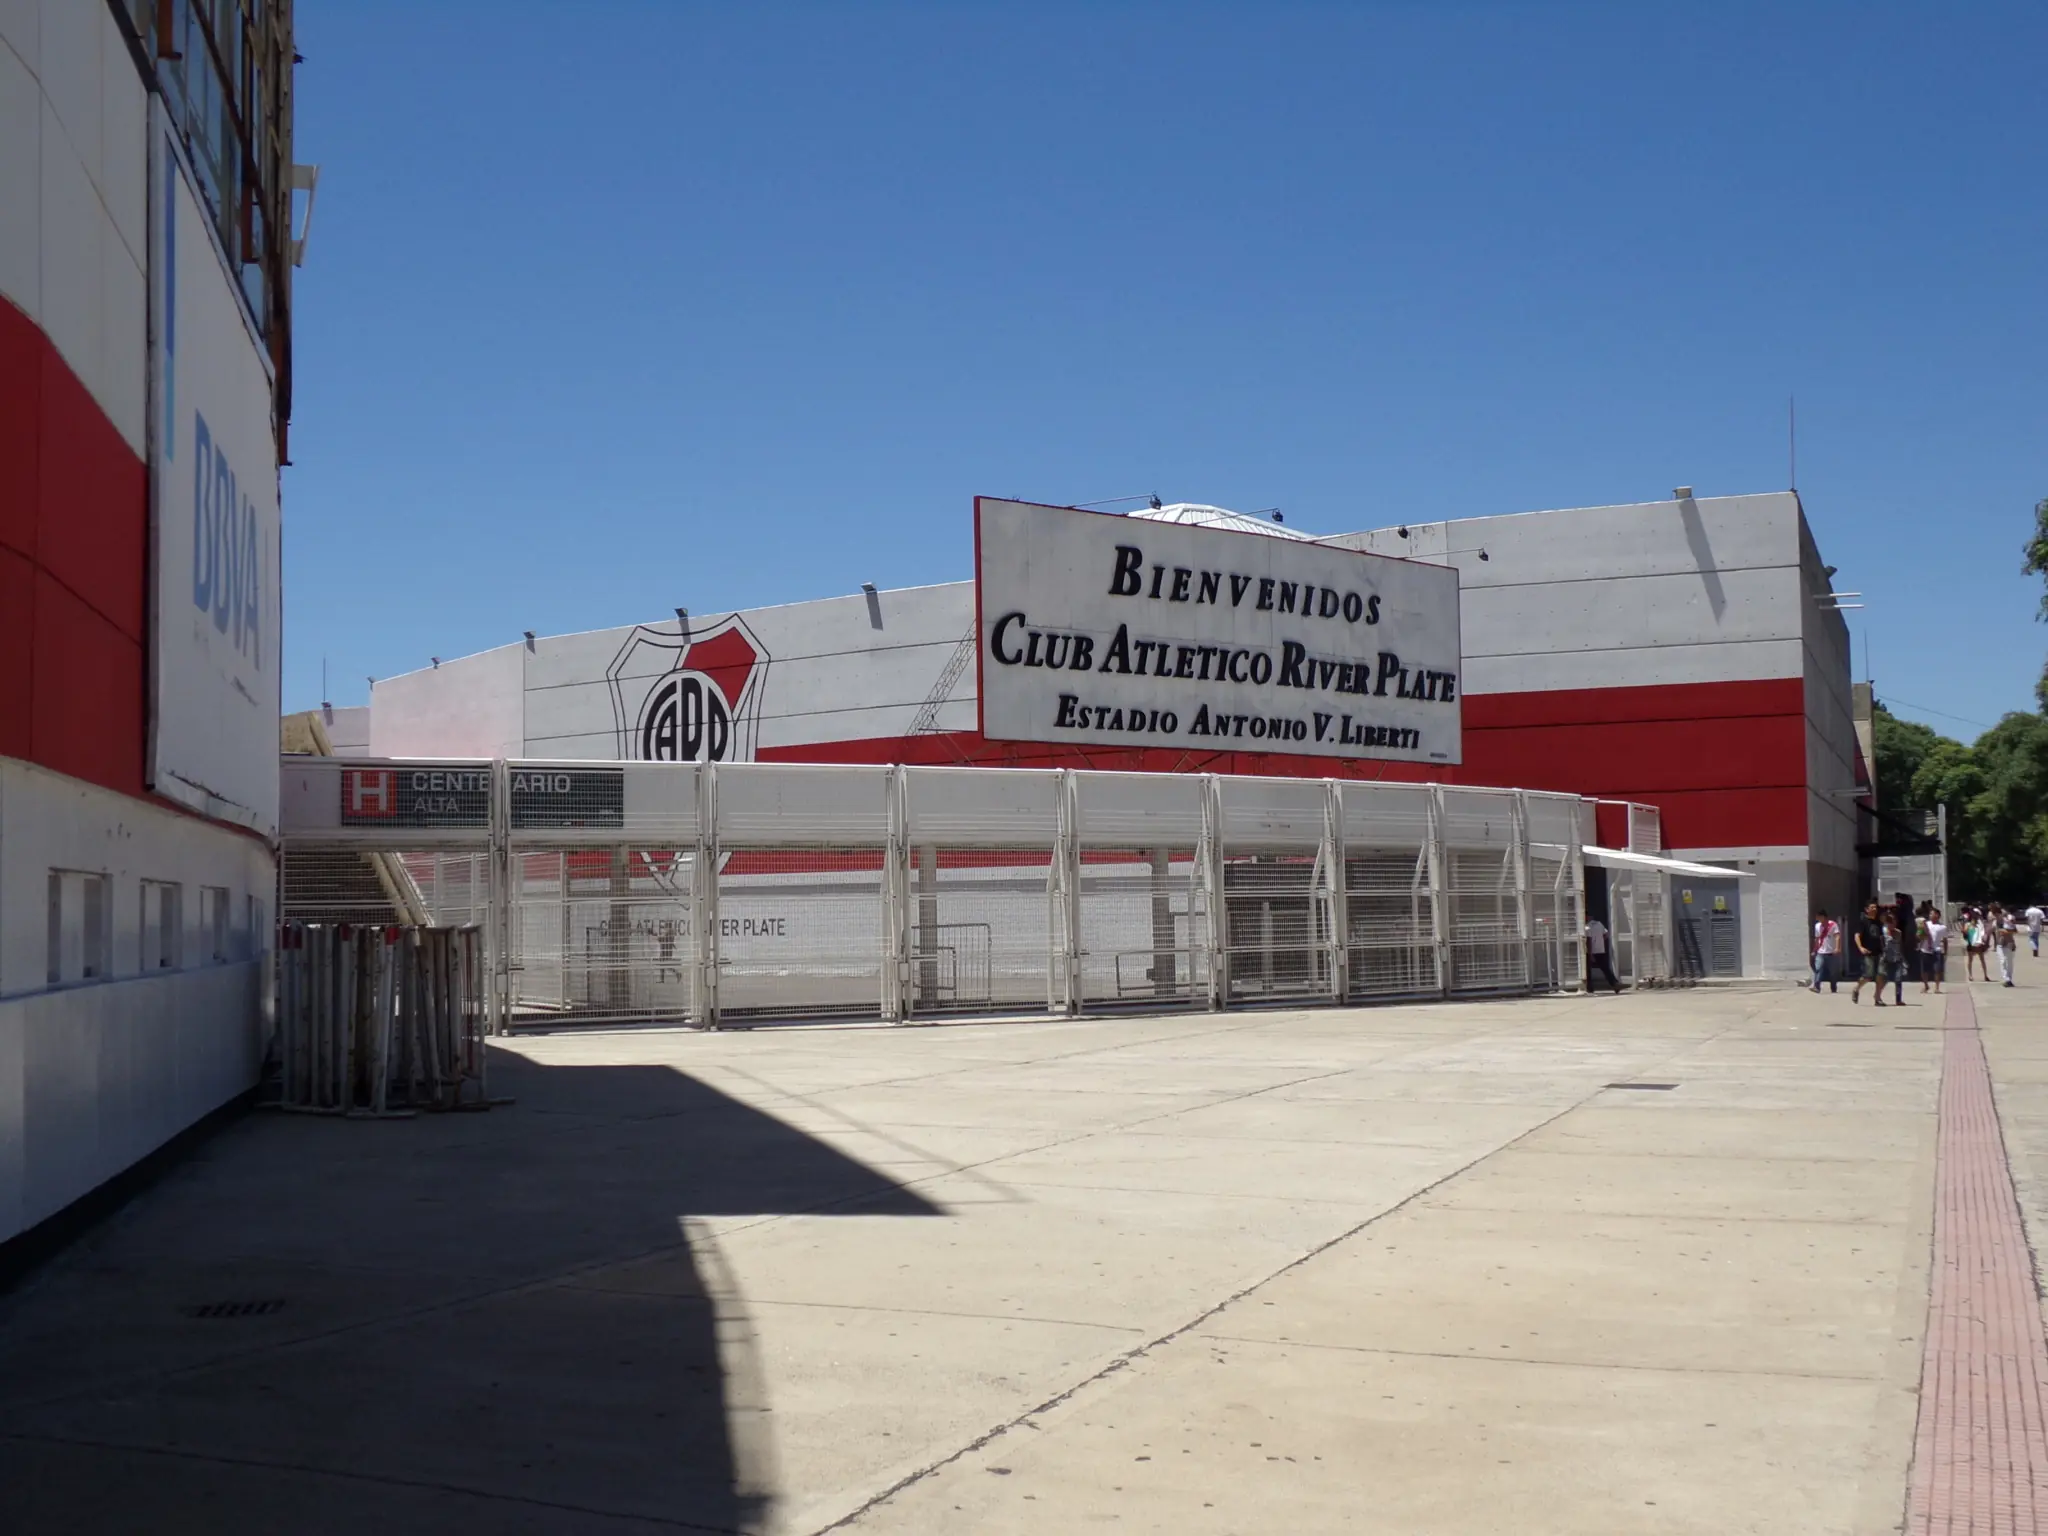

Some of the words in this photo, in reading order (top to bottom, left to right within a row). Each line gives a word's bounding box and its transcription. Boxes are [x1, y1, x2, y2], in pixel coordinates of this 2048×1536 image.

[193, 407, 260, 672] BBVA
[1108, 545, 1381, 625] BIENVENIDOS
[991, 612, 1094, 670] CLUB
[1098, 623, 1272, 685] ATLETICO
[1276, 640, 1370, 695] RIVER
[1372, 652, 1456, 702] PLATE
[1053, 694, 1178, 734] ESTADIO
[1188, 703, 1308, 741] ANTONIO
[1339, 715, 1420, 749] LIBERTI
[352, 771, 388, 812] H
[412, 772, 571, 793] CENTEARIO
[413, 797, 460, 813] ALTA
[743, 918, 786, 937] PLATE
